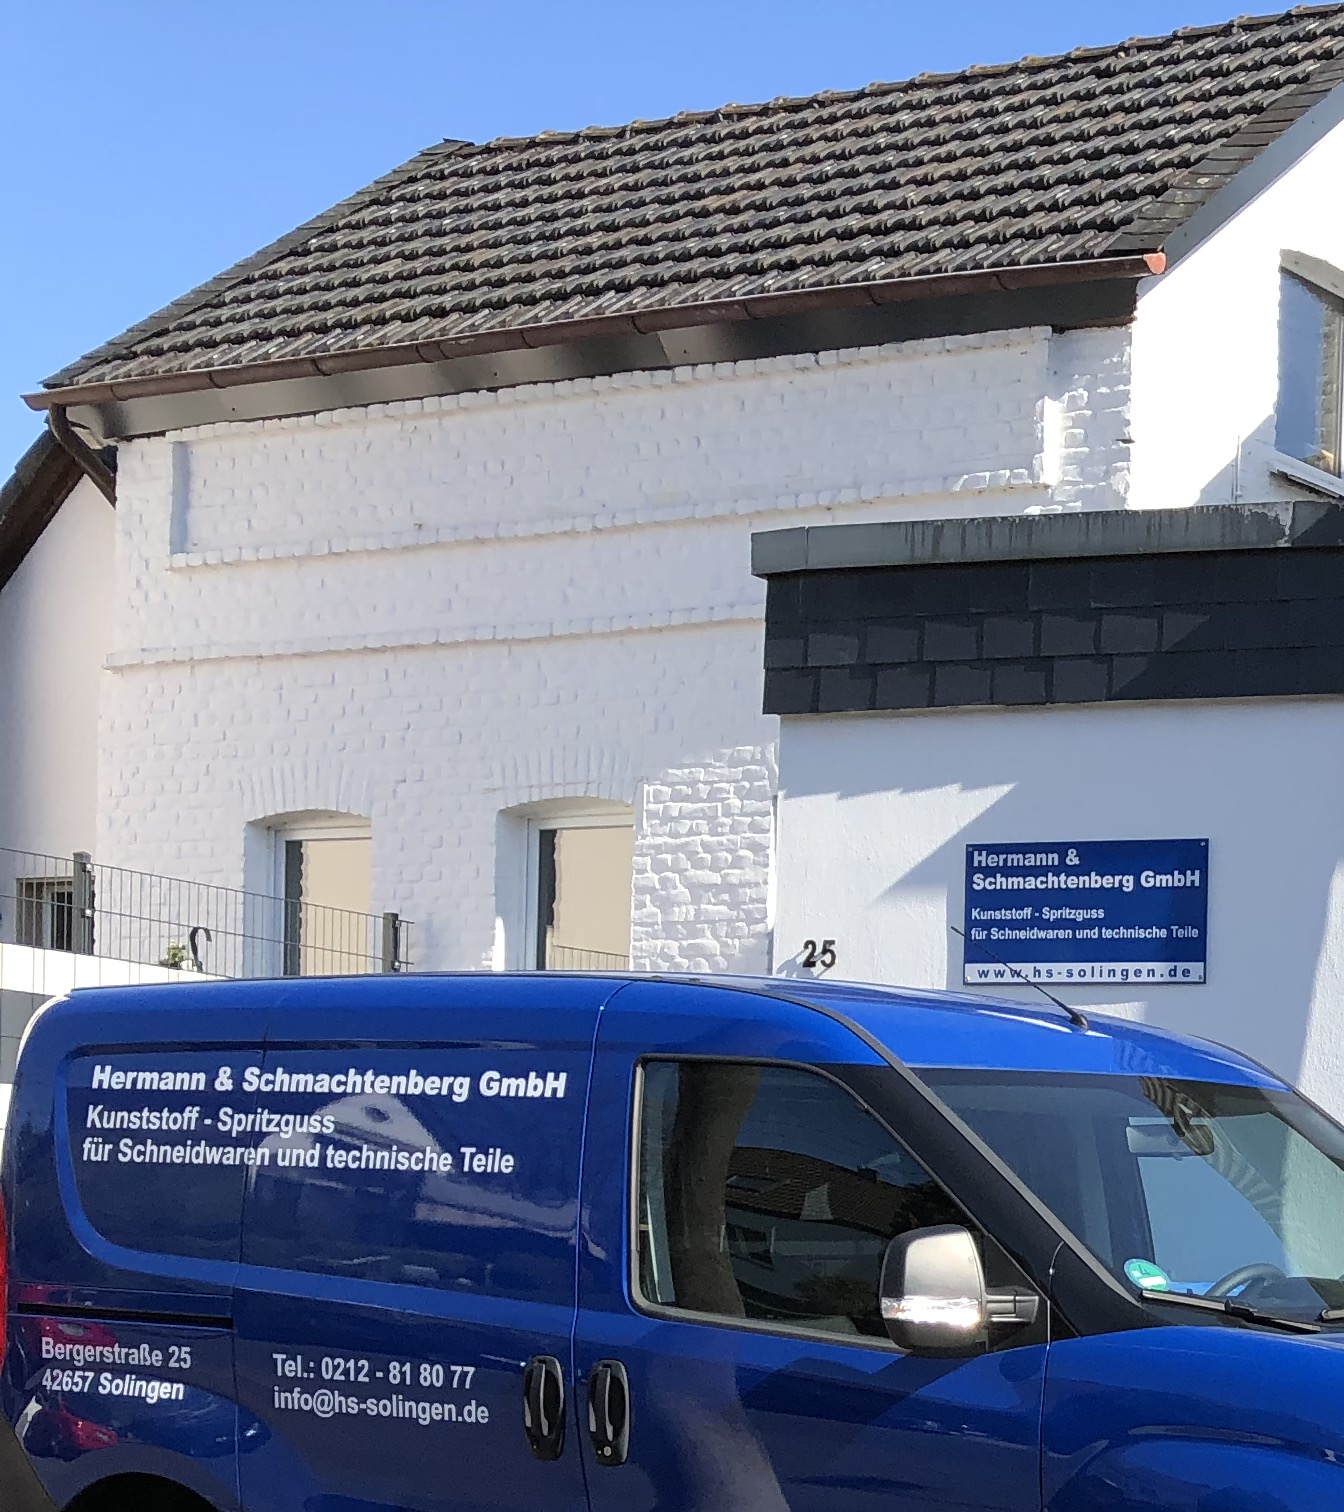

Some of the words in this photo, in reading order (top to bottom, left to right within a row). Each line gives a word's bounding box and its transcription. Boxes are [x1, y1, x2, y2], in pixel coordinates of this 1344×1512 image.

[973, 850, 1059, 867] Hermann
[1065, 848, 1080, 866] &
[972, 871, 1134, 892] Schmachtenberg
[1140, 870, 1200, 887] GmbH
[971, 907, 1032, 920] Kunststoff
[1041, 907, 1105, 922] Spritzguss
[971, 927, 988, 940] für
[990, 927, 1072, 940] Schneidwaren
[1075, 927, 1099, 939] und
[1102, 926, 1167, 939] technische
[1170, 925, 1199, 938] Teile
[803, 940, 837, 968] 25
[977, 965, 1191, 981] www.hs-solingen.de
[92, 1065, 206, 1090] Hermann
[214, 1066, 234, 1091] &
[242, 1067, 471, 1102] Schmachtenberg
[479, 1070, 567, 1098] GmbH
[86, 1105, 200, 1130] Kunststoff
[217, 1107, 335, 1138] Spritzguss
[83, 1137, 115, 1162] für
[117, 1138, 270, 1166] Schneidwaren
[276, 1142, 319, 1168] und
[326, 1144, 452, 1171] technische
[460, 1147, 515, 1173] Teile
[41, 1337, 163, 1367] Bergerstraße
[168, 1346, 191, 1368] 25
[42, 1369, 95, 1393] 42657
[98, 1372, 185, 1404] Solingen
[272, 1353, 315, 1379] Tel.:
[321, 1357, 370, 1382] 0212
[388, 1361, 412, 1385] 81
[419, 1363, 444, 1387] 80
[450, 1365, 475, 1389] 77
[274, 1386, 489, 1425] info@hs-solingen.de
